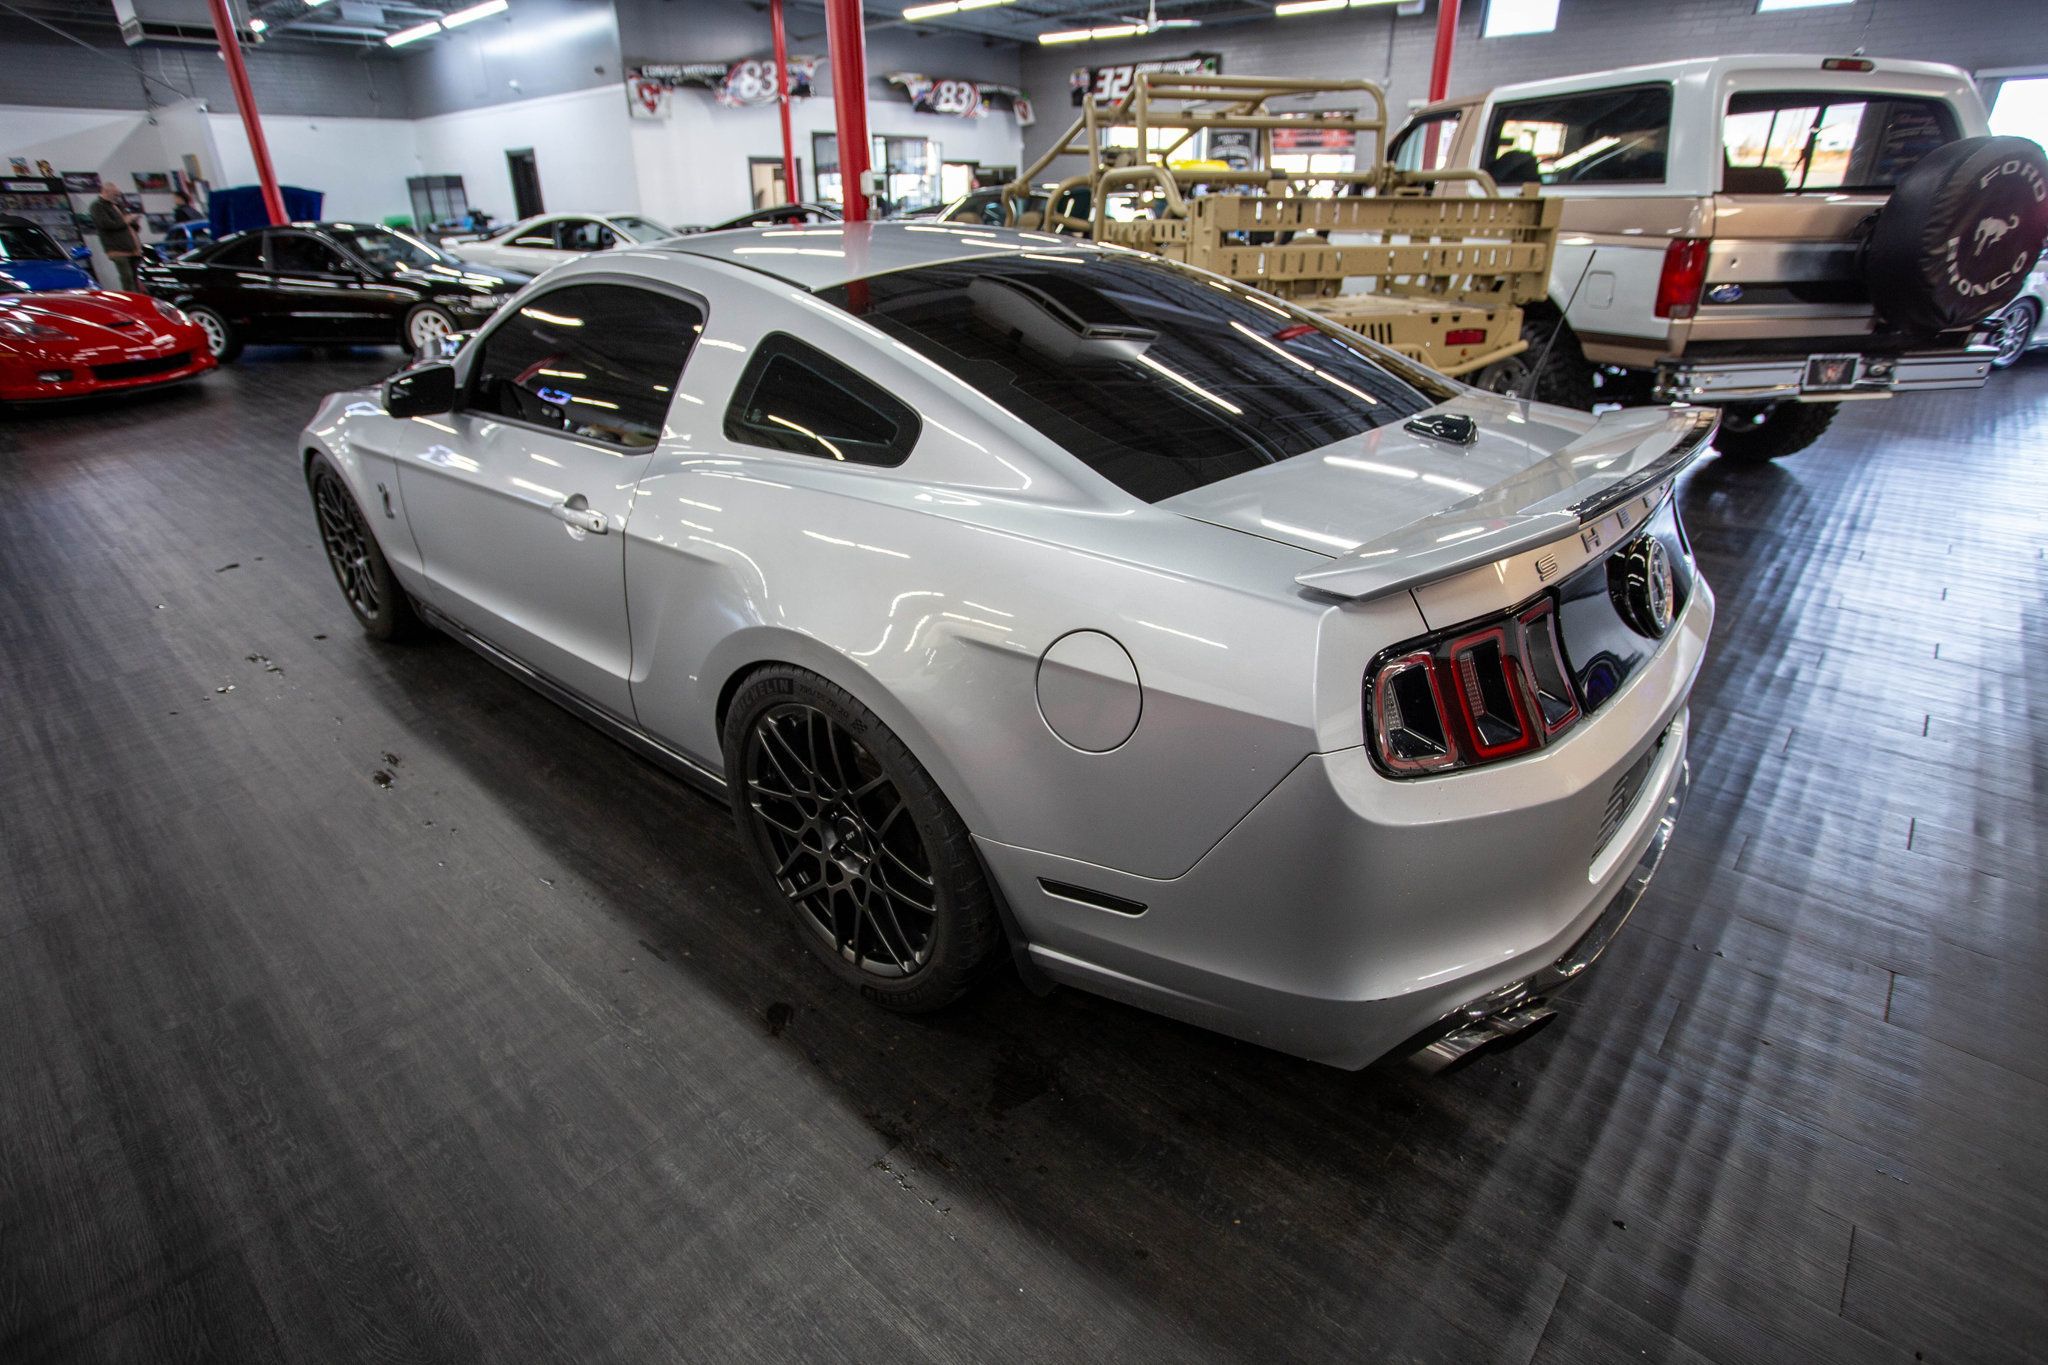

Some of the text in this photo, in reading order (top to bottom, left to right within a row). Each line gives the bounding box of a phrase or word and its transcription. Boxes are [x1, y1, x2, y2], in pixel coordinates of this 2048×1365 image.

[739, 60, 778, 99] 83
[936, 80, 971, 112] 83
[1092, 65, 1134, 101] 32
[1980, 160, 2047, 202] FORD
